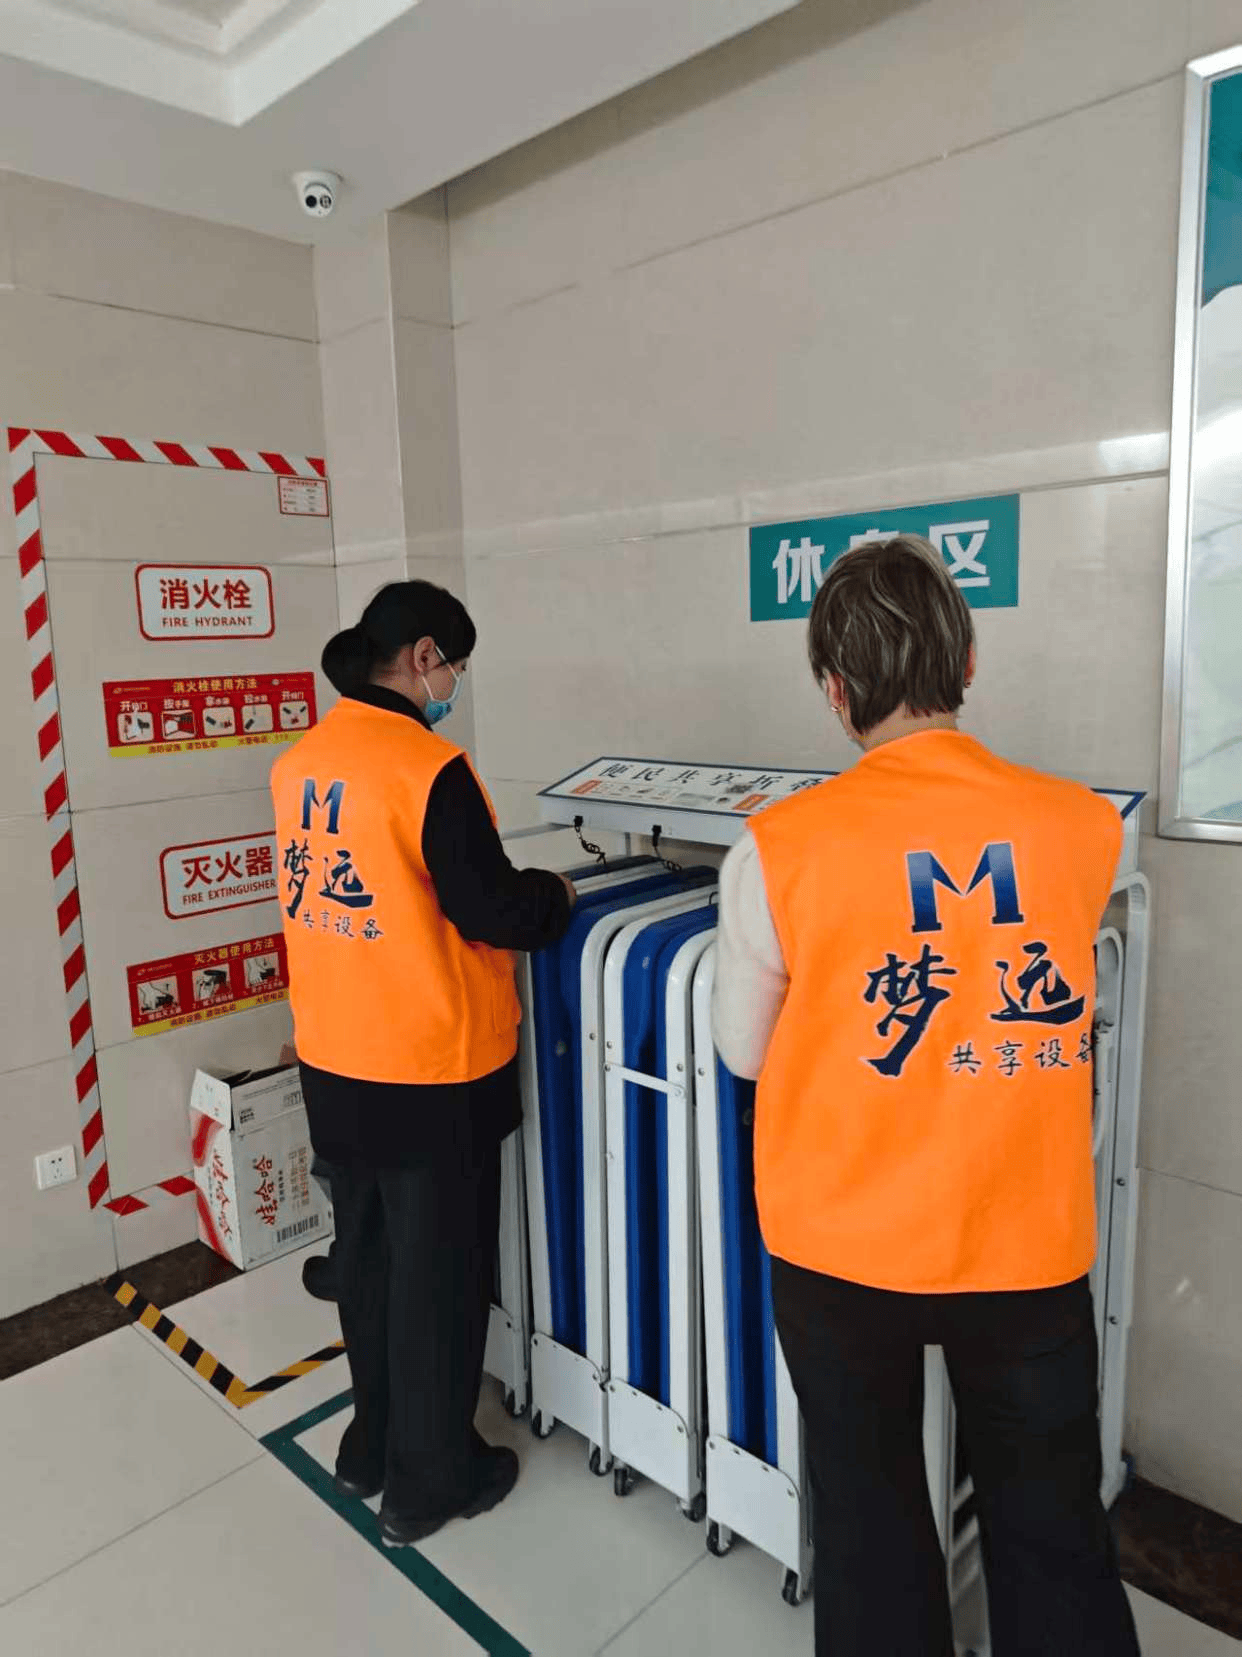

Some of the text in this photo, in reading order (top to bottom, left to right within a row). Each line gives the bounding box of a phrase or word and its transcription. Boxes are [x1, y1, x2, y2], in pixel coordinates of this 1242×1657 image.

[159, 578, 252, 610] 消火栓
[161, 615, 253, 628] FIRE HYDRANT
[173, 678, 257, 693] 消火栓使用方法
[302, 779, 345, 835] M
[182, 846, 273, 888] 灭火器
[284, 838, 374, 919] 梦远
[182, 879, 277, 905] FIRE EXTINGUISHER
[907, 842, 1025, 933] M
[303, 909, 384, 940] 共享设备
[194, 938, 274, 965] 灭火器使用方法
[863, 943, 1085, 1077] 梦远
[254, 1155, 278, 1226] 娃哈哈
